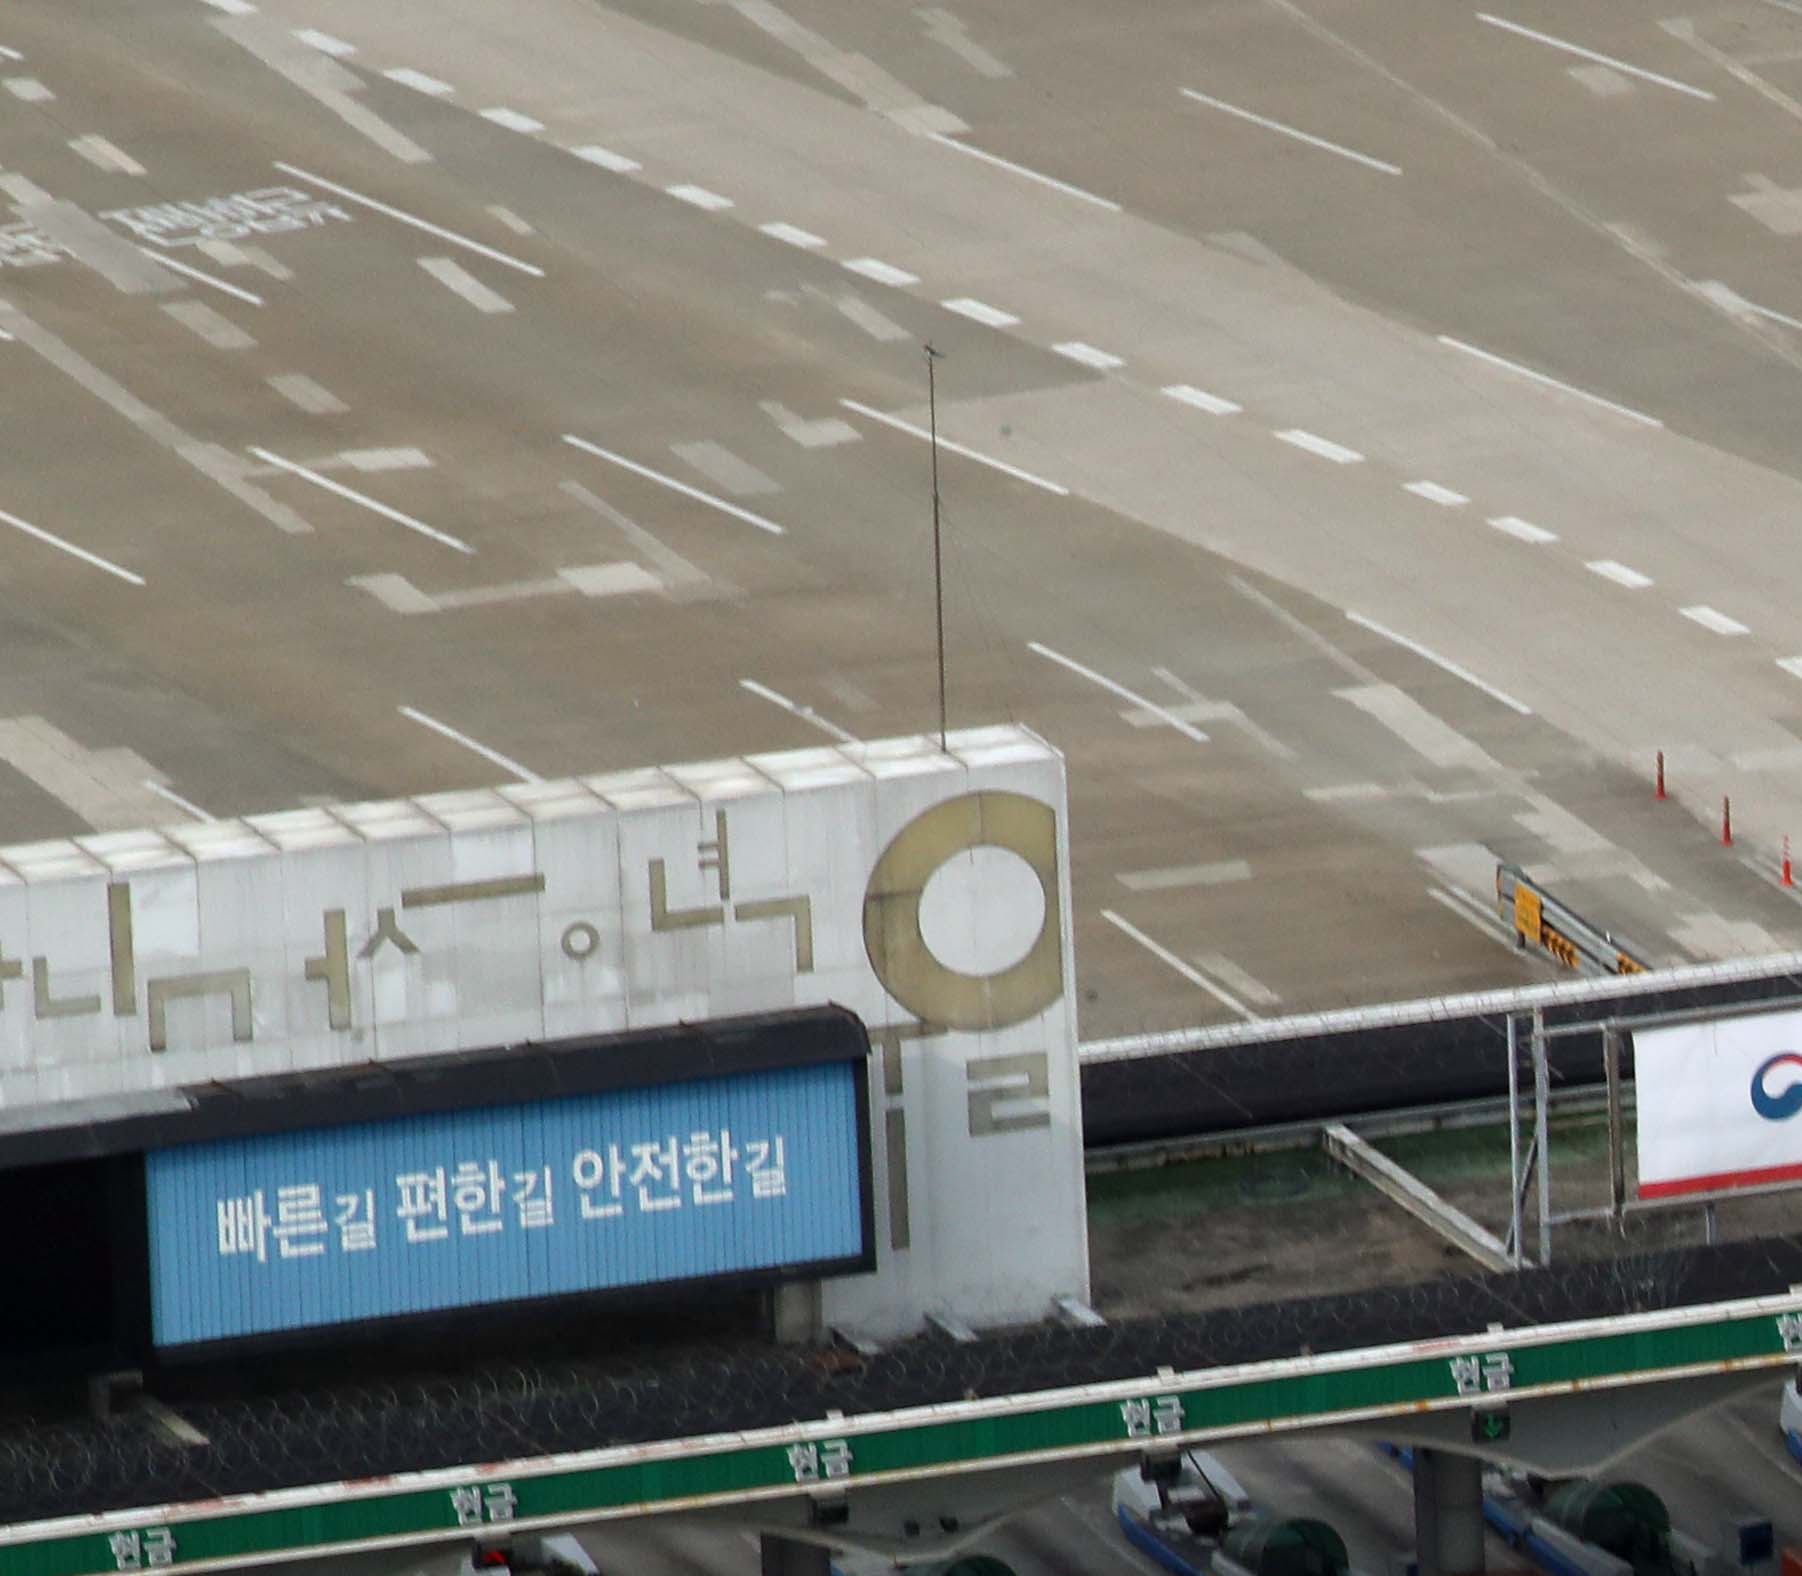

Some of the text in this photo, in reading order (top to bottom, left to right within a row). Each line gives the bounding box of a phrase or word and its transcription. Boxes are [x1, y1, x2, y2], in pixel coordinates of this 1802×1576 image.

[217, 1127, 788, 1263] 빠른길 편한길 안전한길
